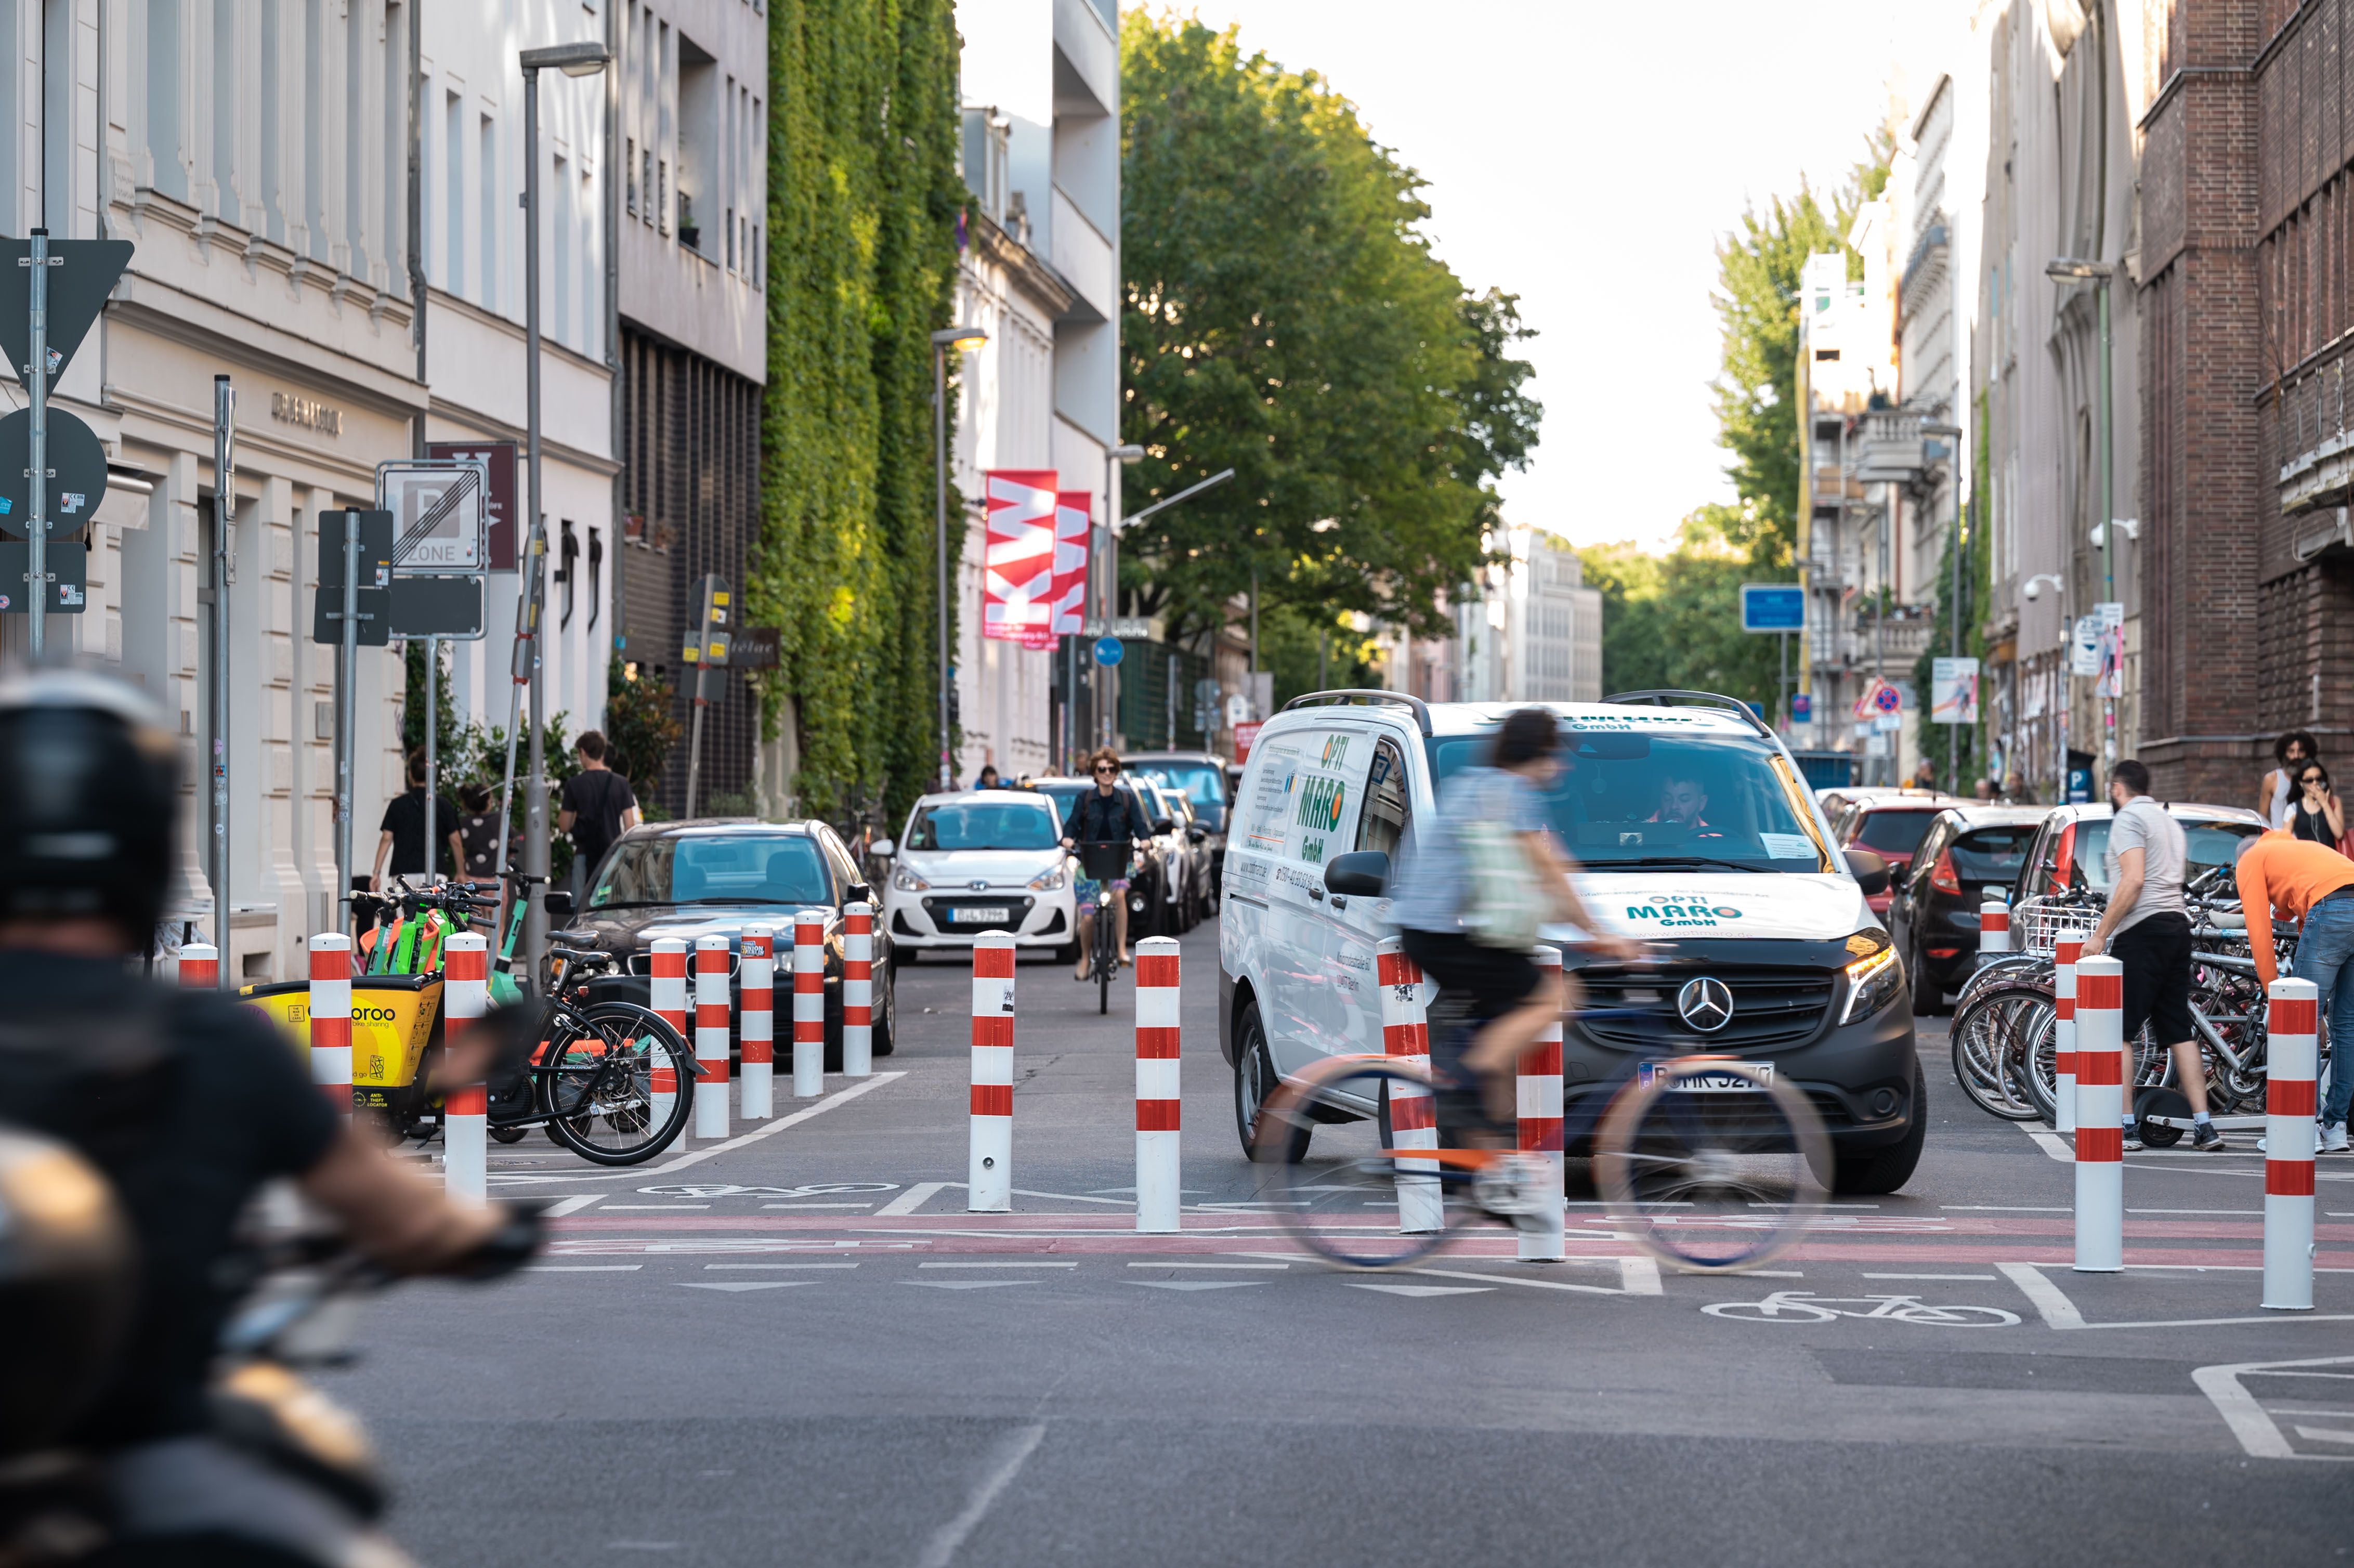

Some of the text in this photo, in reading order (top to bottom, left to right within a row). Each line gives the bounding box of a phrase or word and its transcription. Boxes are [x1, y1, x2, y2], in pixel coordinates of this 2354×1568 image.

[408, 546, 455, 561] ZONE
[1321, 734, 1350, 770] OPTI
[2071, 771, 2083, 789] P
[1296, 775, 1345, 832] MARO
[1302, 835, 1324, 864] GmbH
[1649, 896, 1708, 904] OPTI
[1626, 905, 1743, 919] MARO
[1634, 930, 1753, 939] www.optimaro.de
